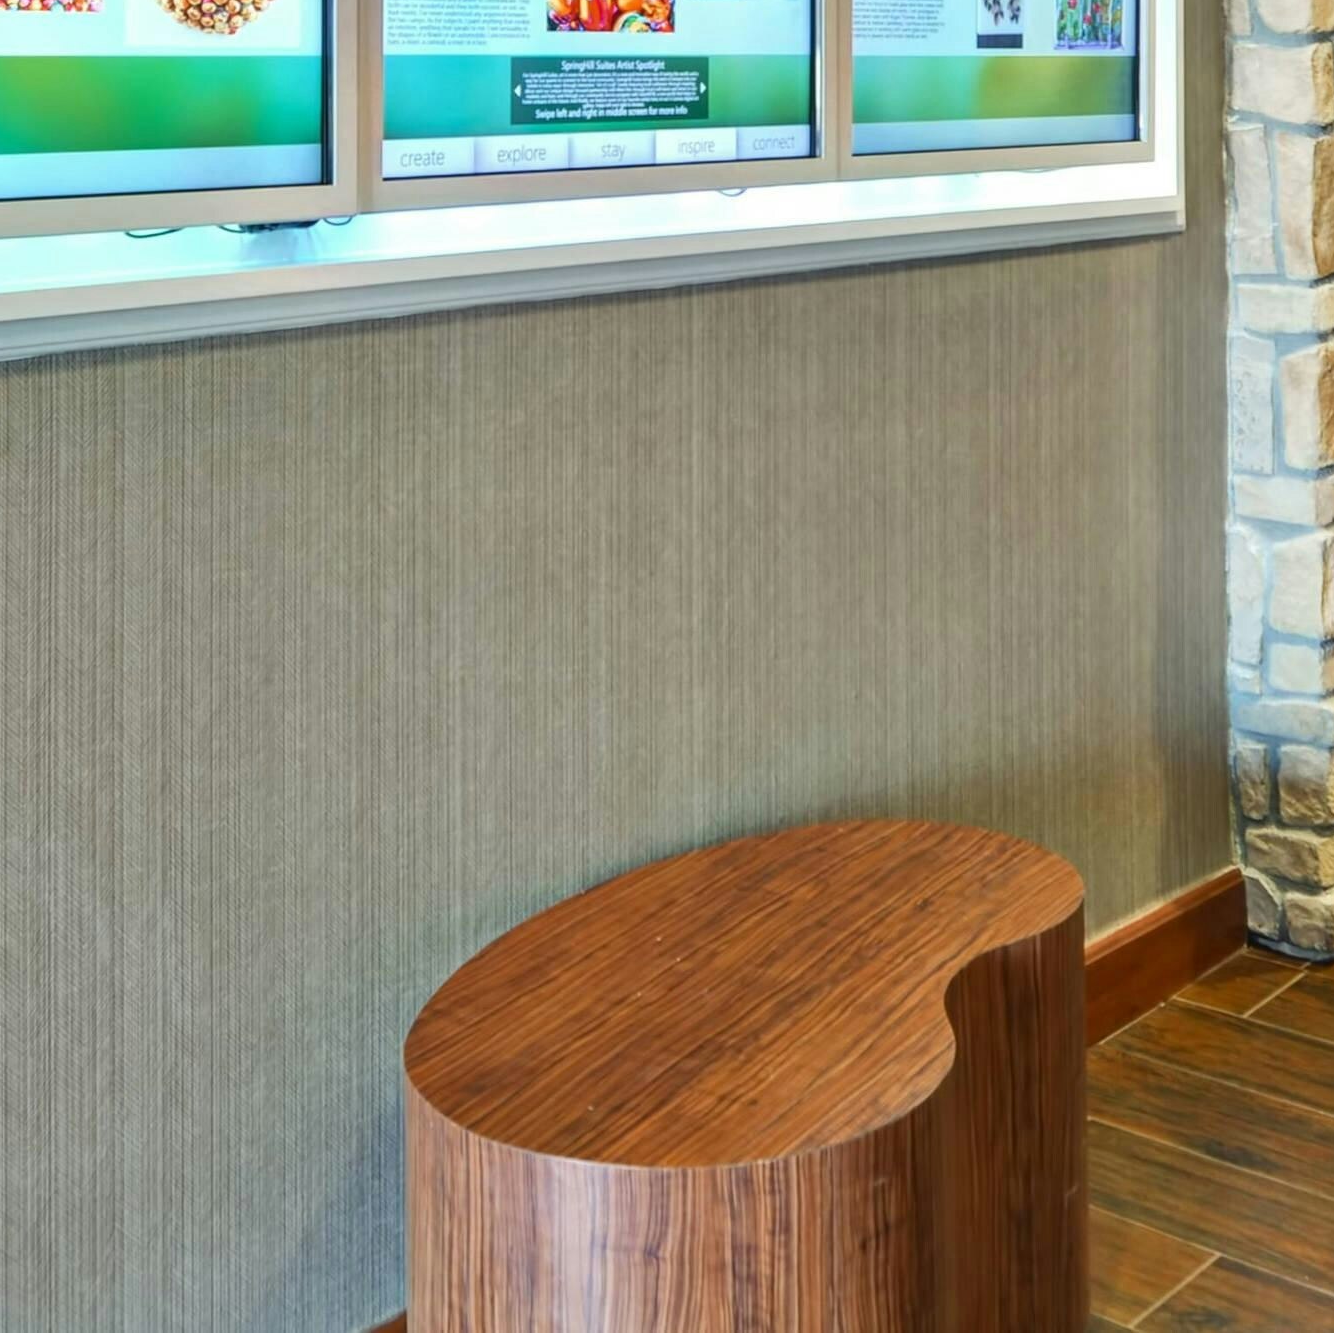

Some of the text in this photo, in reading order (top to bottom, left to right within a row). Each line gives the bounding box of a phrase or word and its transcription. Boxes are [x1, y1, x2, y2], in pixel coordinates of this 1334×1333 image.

[636, 59, 665, 72] Spotlight
[535, 109, 555, 121] Swipe
[556, 108, 567, 119] left
[568, 108, 581, 118] and
[582, 107, 597, 120] right
[605, 106, 627, 117] middle
[628, 107, 647, 116] screen
[648, 106, 658, 116] for
[658, 107, 675, 116] more
[675, 105, 688, 115] info
[601, 140, 625, 161] stay
[677, 137, 716, 156] inspire
[752, 133, 796, 152] connect
[400, 149, 445, 168] create
[497, 144, 547, 165] explore
